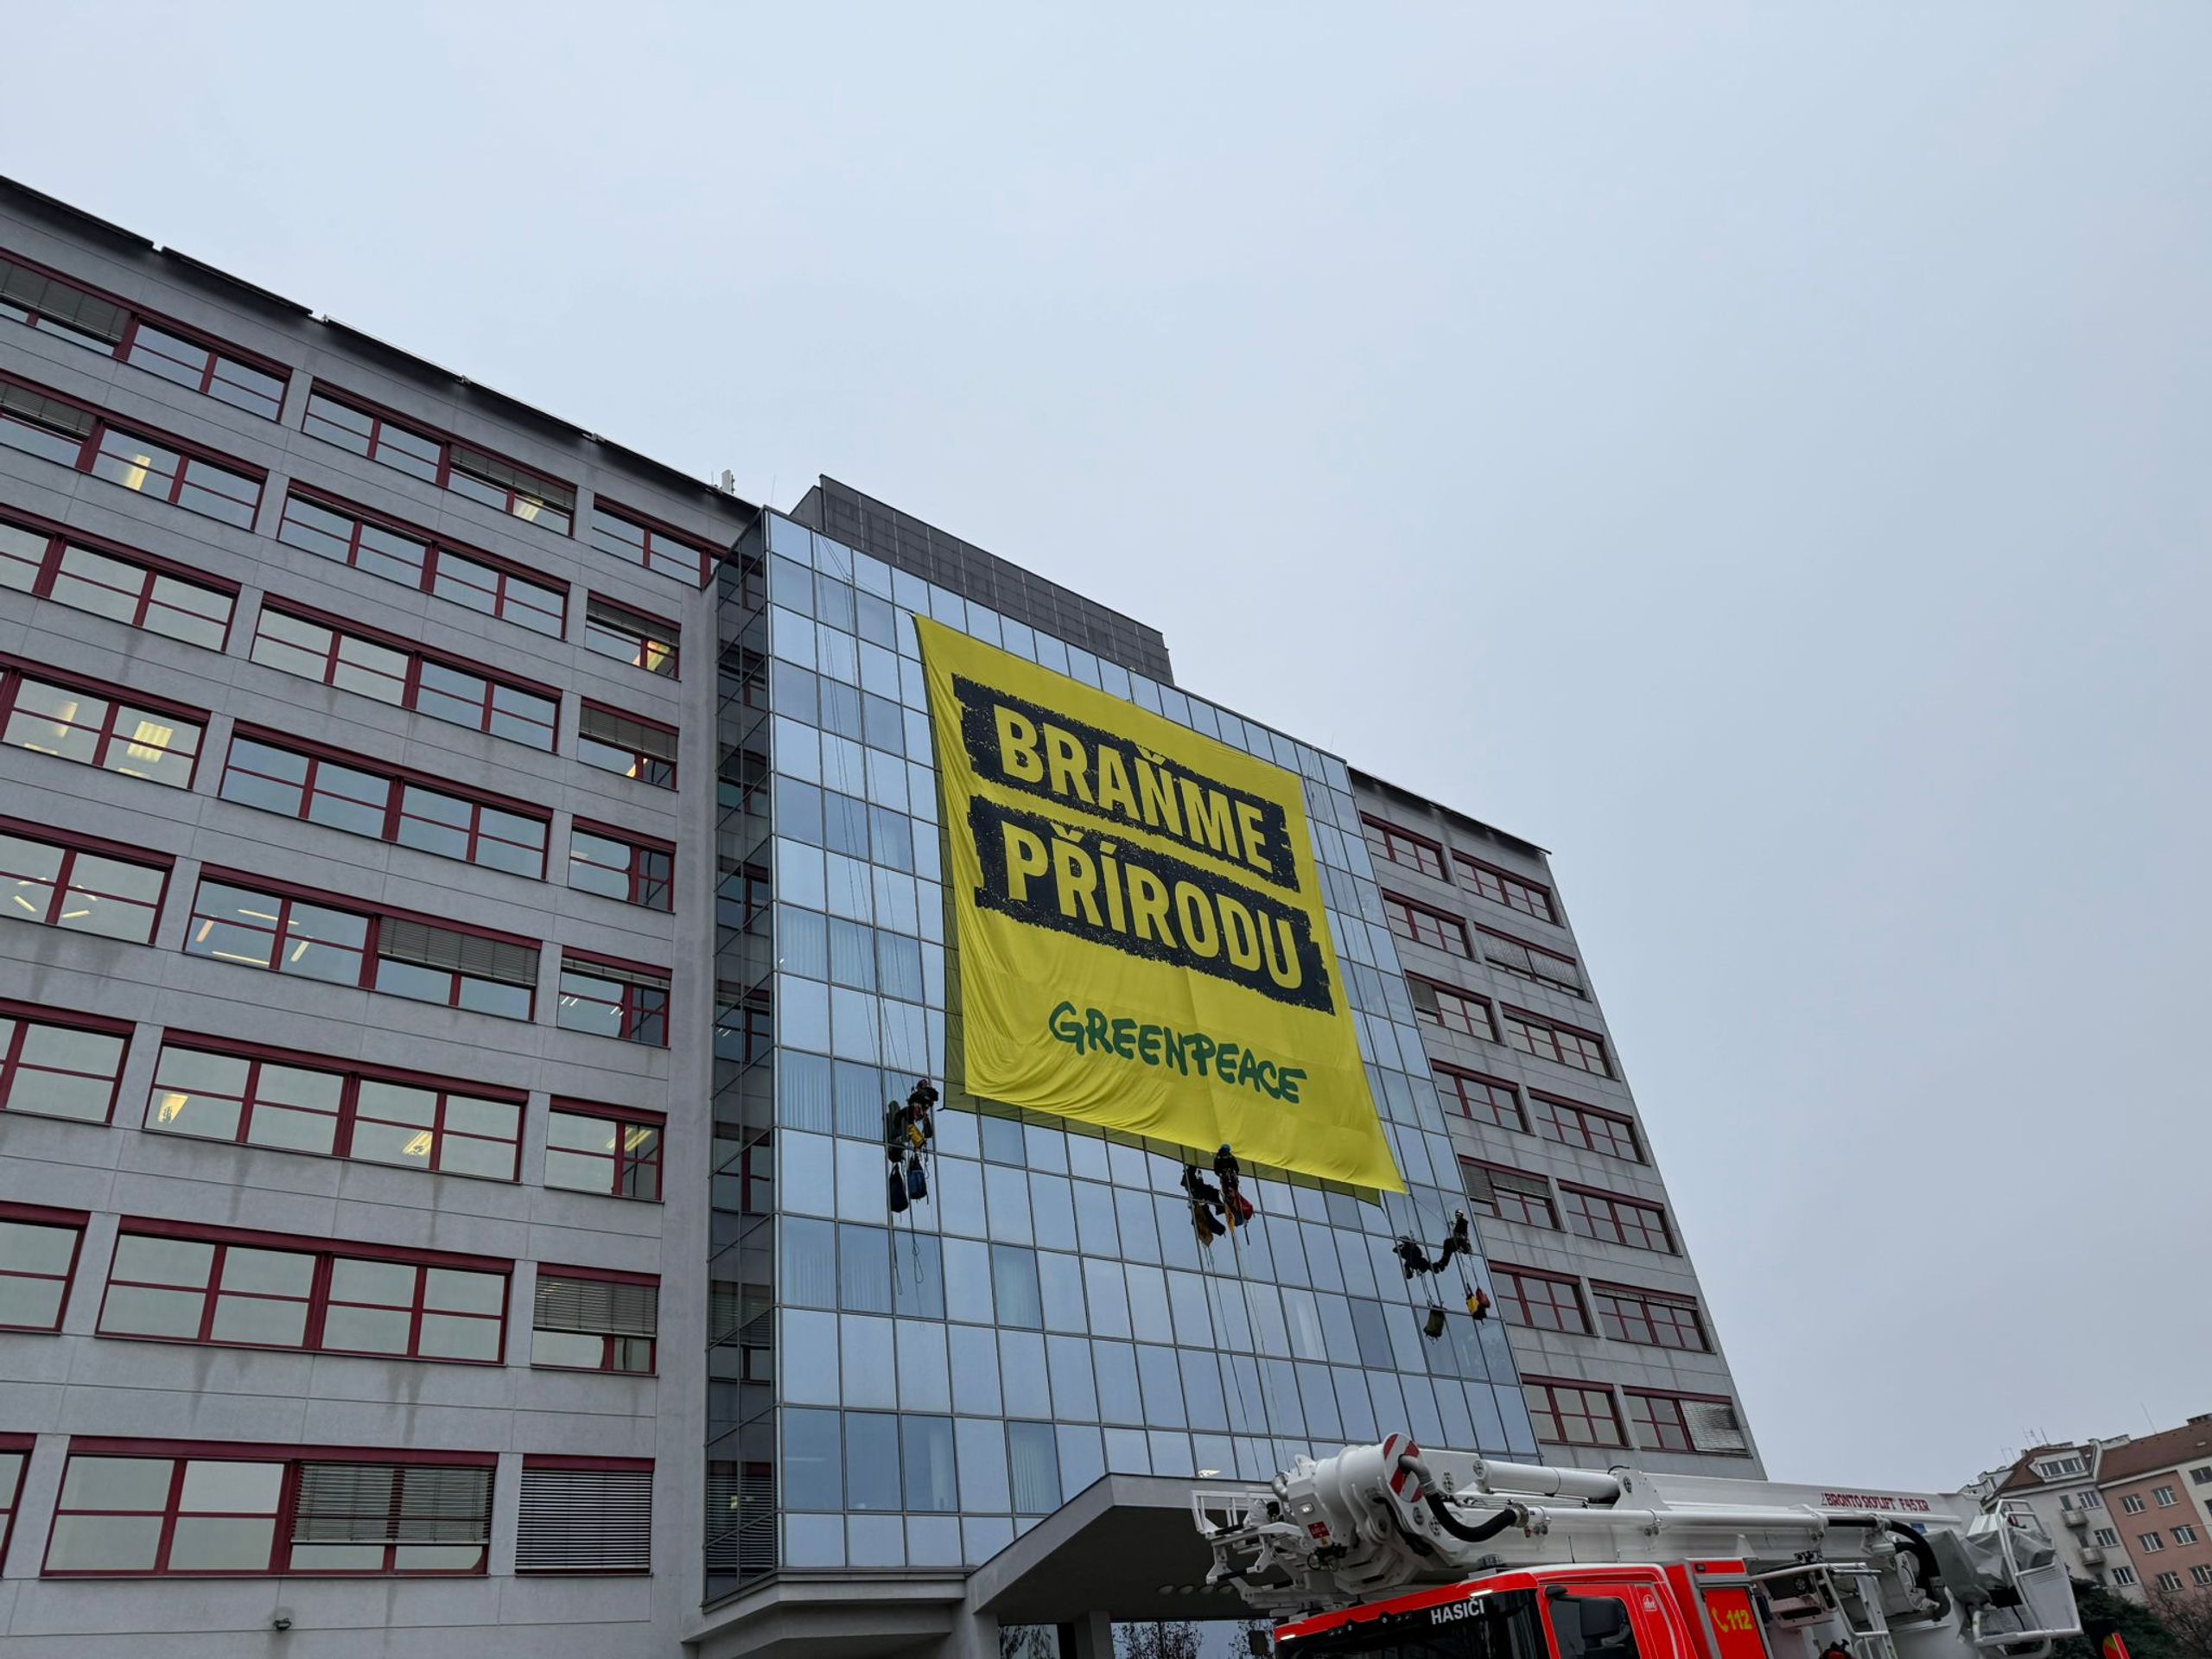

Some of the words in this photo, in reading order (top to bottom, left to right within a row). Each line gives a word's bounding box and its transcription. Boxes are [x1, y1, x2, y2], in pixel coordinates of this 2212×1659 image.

[994, 703, 1273, 873] BRAŇME
[1001, 820, 1303, 990] PŘÍRODU
[1048, 1001, 1307, 1104] GREENPEACE
[1825, 1493, 1863, 1509] BRONTO
[1861, 1496, 1896, 1510] SKYLIFT
[1430, 1596, 1485, 1625] HASIČI
[1726, 1609, 1752, 1630] 112
